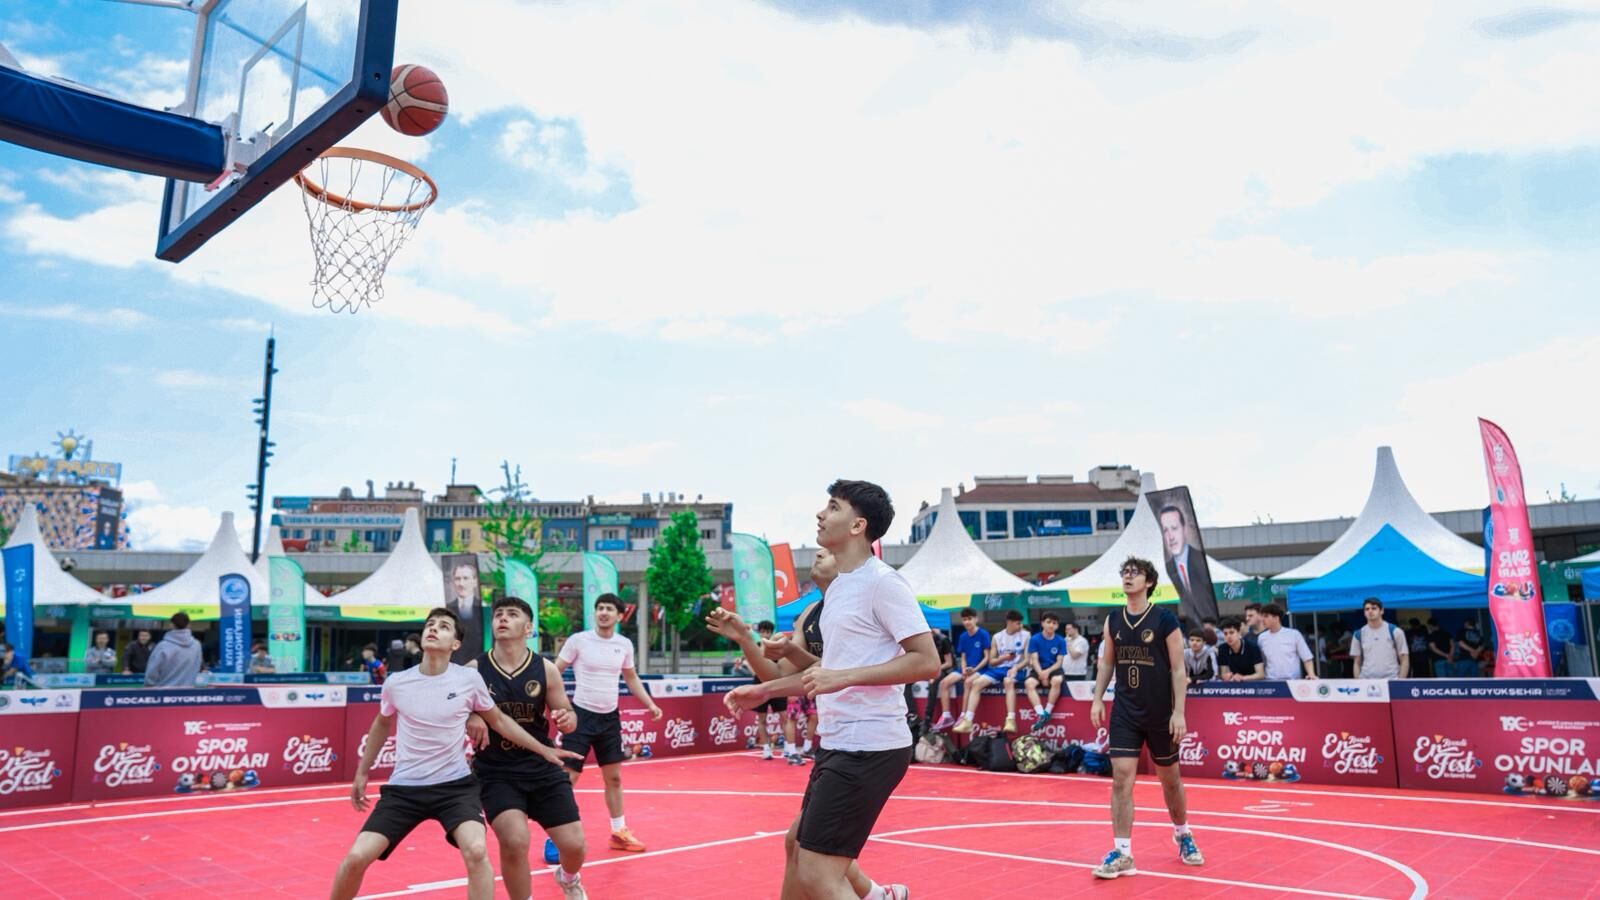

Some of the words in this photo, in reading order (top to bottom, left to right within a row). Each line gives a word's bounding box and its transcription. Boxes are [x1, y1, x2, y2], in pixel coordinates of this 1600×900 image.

[196, 737, 248, 754] SPOR
[1236, 729, 1283, 745] SPOR
[1217, 744, 1307, 762] OYUNLARI
[1520, 737, 1586, 756] SPOR
[172, 752, 269, 772] OYUNLARI
